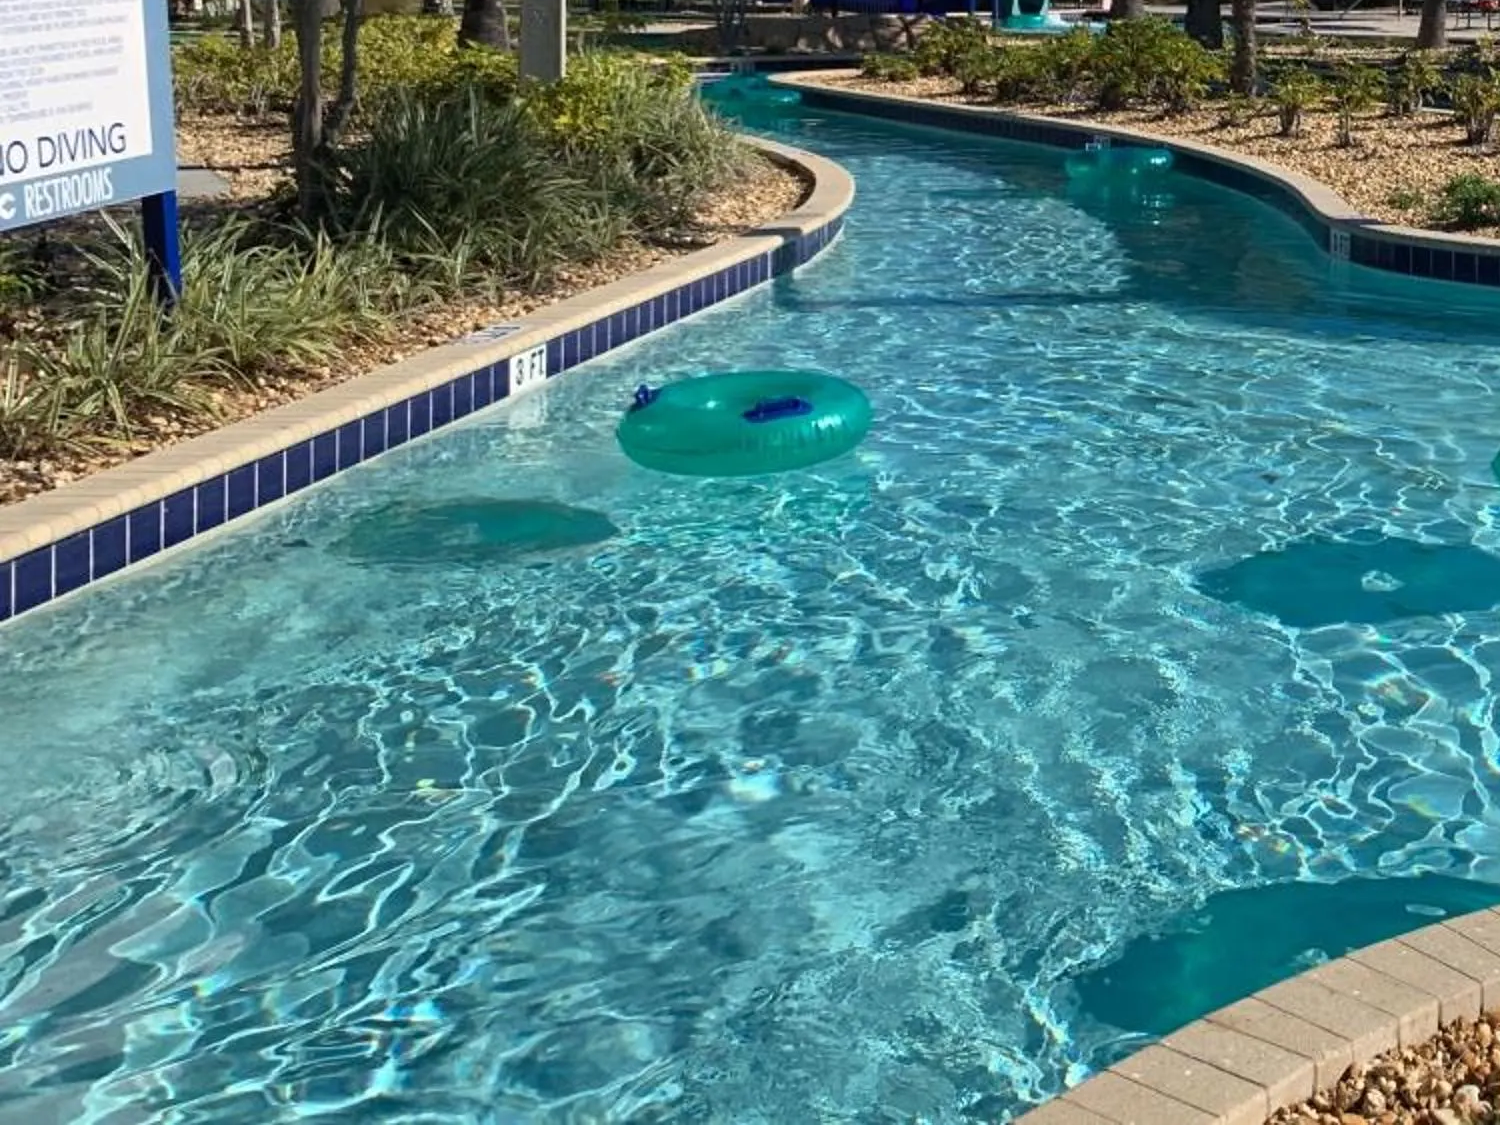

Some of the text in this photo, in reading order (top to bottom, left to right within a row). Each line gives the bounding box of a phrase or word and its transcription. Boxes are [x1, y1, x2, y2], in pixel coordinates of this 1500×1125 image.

[0, 122, 127, 175] O DIVING
[23, 166, 114, 220] RESTROOMS
[515, 357, 525, 386] 3
